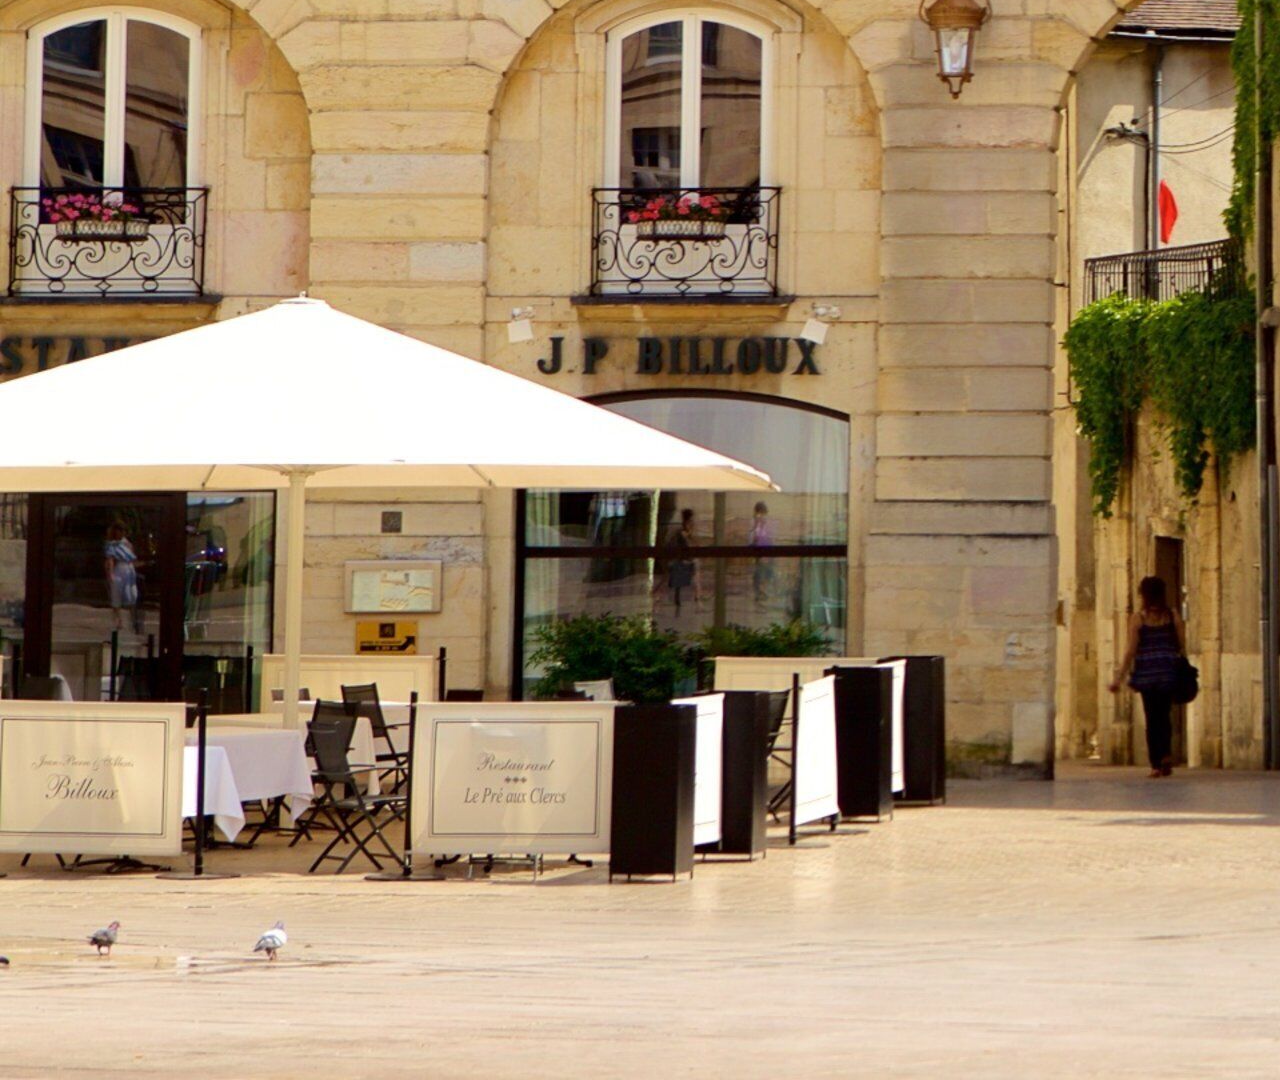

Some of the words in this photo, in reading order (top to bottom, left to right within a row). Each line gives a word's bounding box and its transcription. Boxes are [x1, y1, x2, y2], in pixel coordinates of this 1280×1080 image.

[635, 336, 821, 376] BILLOUX
[476, 751, 556, 772] Restaurant
[44, 773, 119, 801] Billoux
[463, 786, 480, 804] Le
[480, 786, 504, 804] Pré
[505, 791, 528, 804] aux
[529, 786, 567, 805] Clercs
